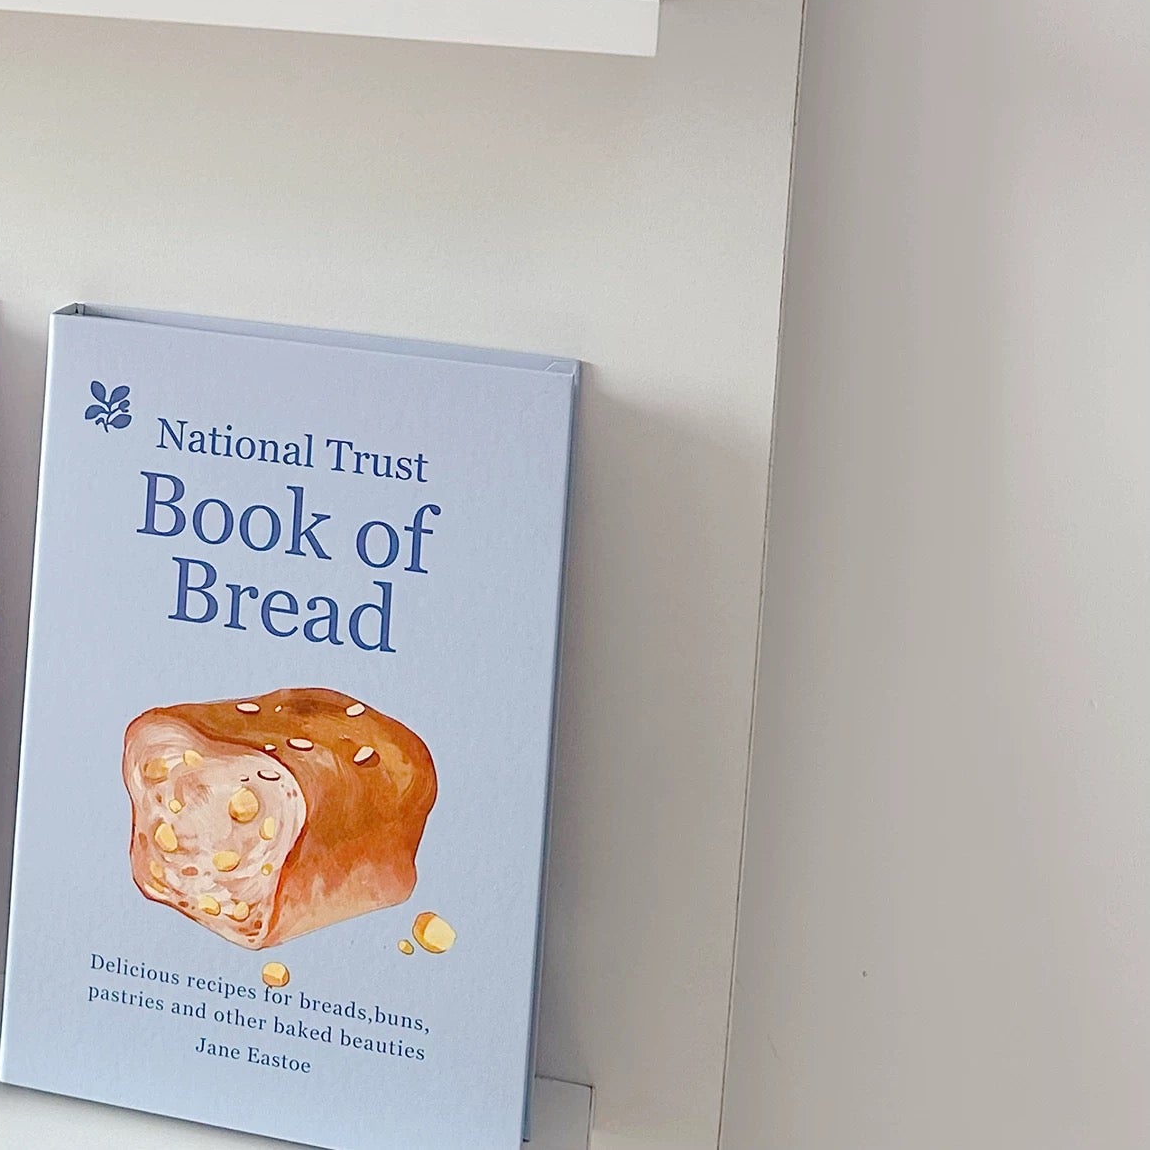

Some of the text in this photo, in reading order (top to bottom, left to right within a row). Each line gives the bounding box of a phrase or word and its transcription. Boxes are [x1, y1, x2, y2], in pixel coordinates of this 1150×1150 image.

[156, 418, 428, 482] National Trust
[136, 471, 441, 574] Book of
[168, 556, 396, 653] Bread
[90, 953, 179, 986] Delicious
[187, 974, 257, 1000] recipes
[264, 986, 293, 1006] for
[88, 984, 426, 1061] pastries and other baked beauties
[196, 1037, 312, 1074] Jane Eastoe
